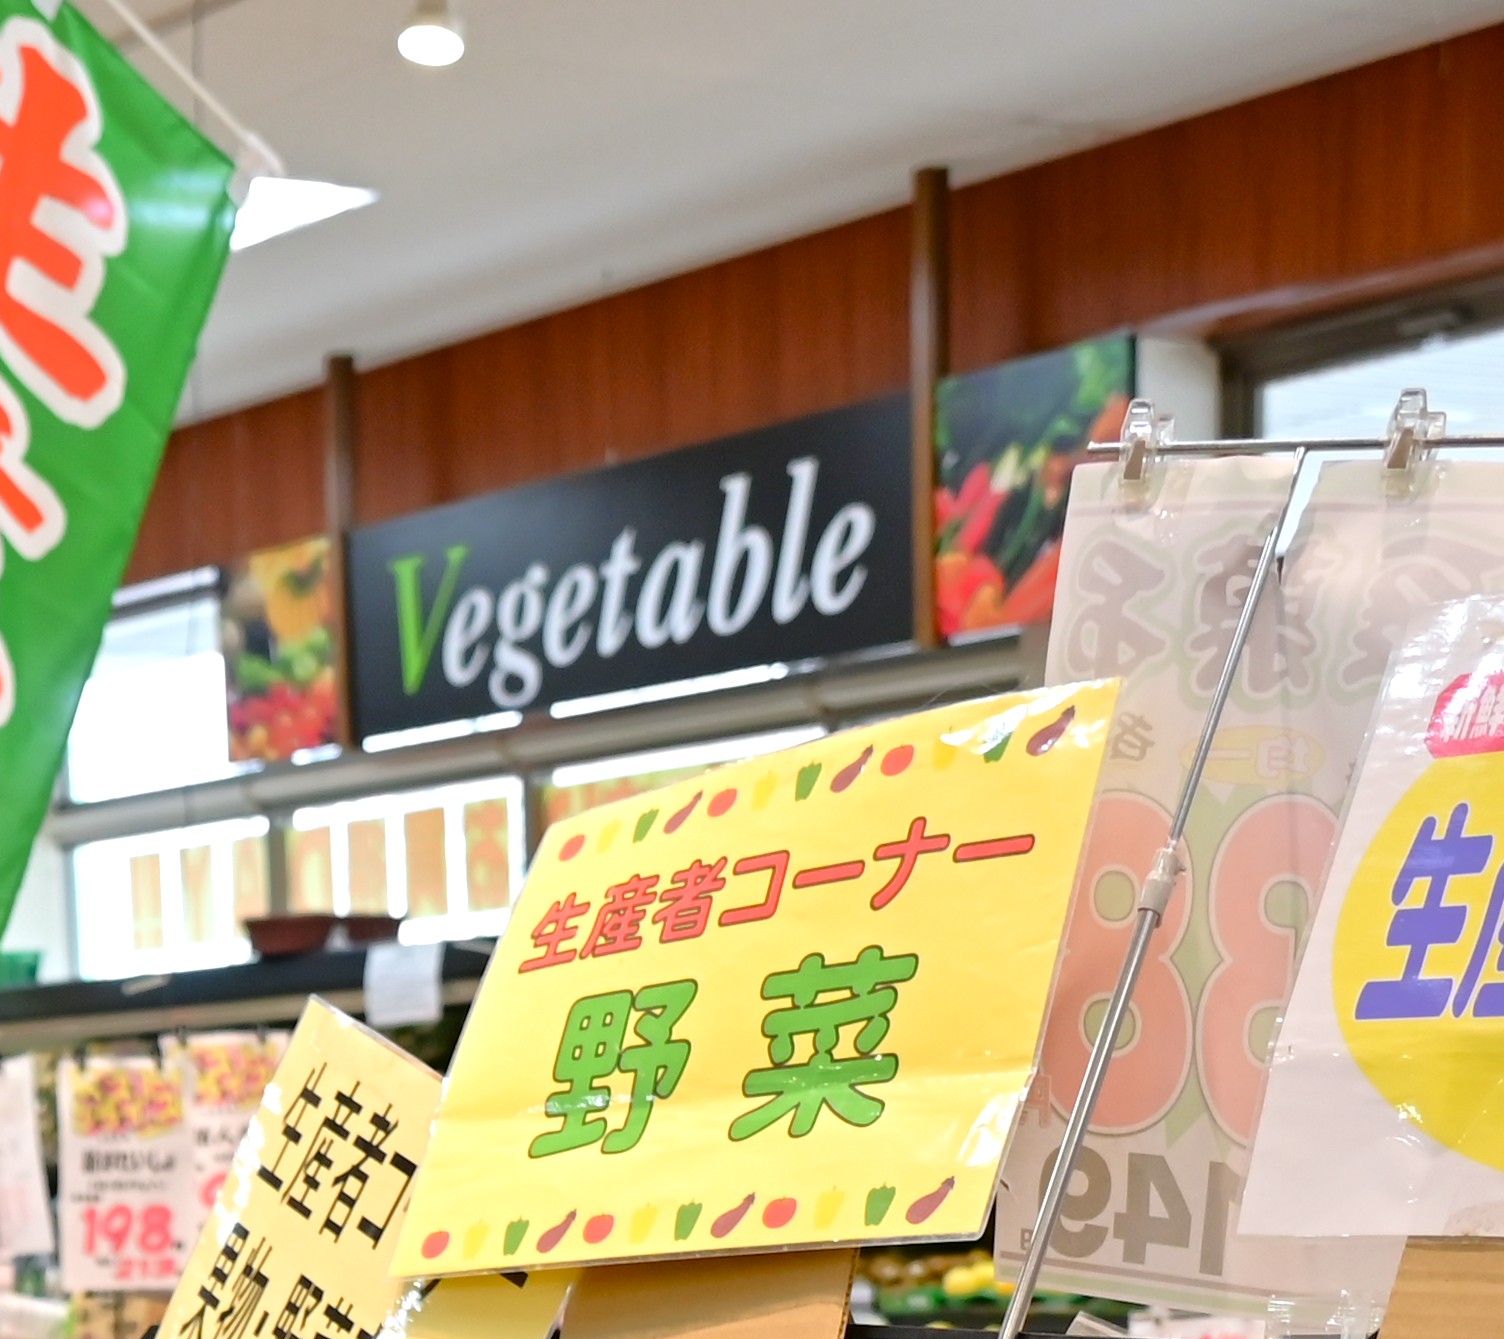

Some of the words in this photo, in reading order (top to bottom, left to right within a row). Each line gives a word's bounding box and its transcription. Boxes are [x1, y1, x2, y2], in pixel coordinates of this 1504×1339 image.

[390, 456, 876, 708] Vegetable
[517, 814, 1035, 976] 生産者コーナー
[527, 944, 922, 1160] 野菜
[82, 1202, 174, 1257] 198
